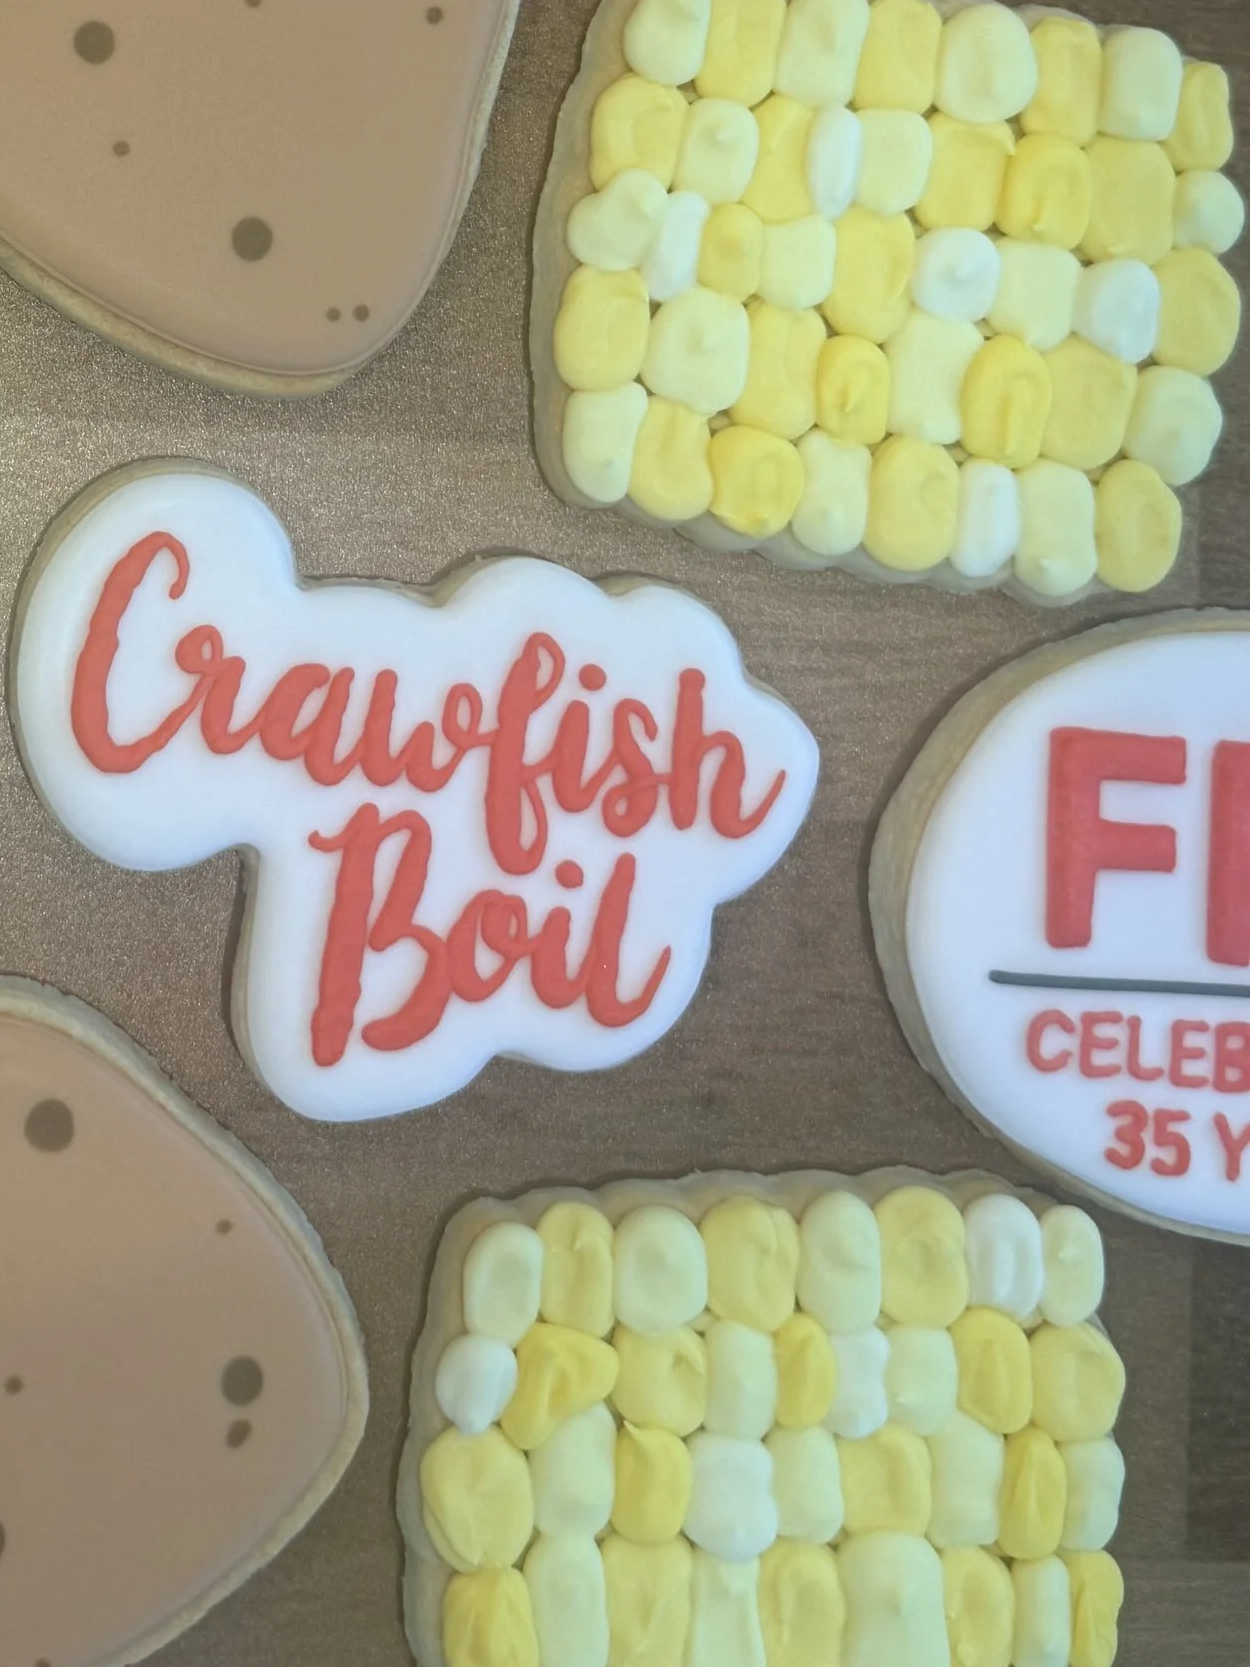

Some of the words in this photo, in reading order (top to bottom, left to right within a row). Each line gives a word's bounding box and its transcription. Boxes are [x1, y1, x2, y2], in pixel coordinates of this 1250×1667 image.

[71, 532, 786, 876] Crawfish
[308, 803, 671, 1067] Boil
[1045, 726, 1250, 967] F
[1104, 1100, 1191, 1177] 35
